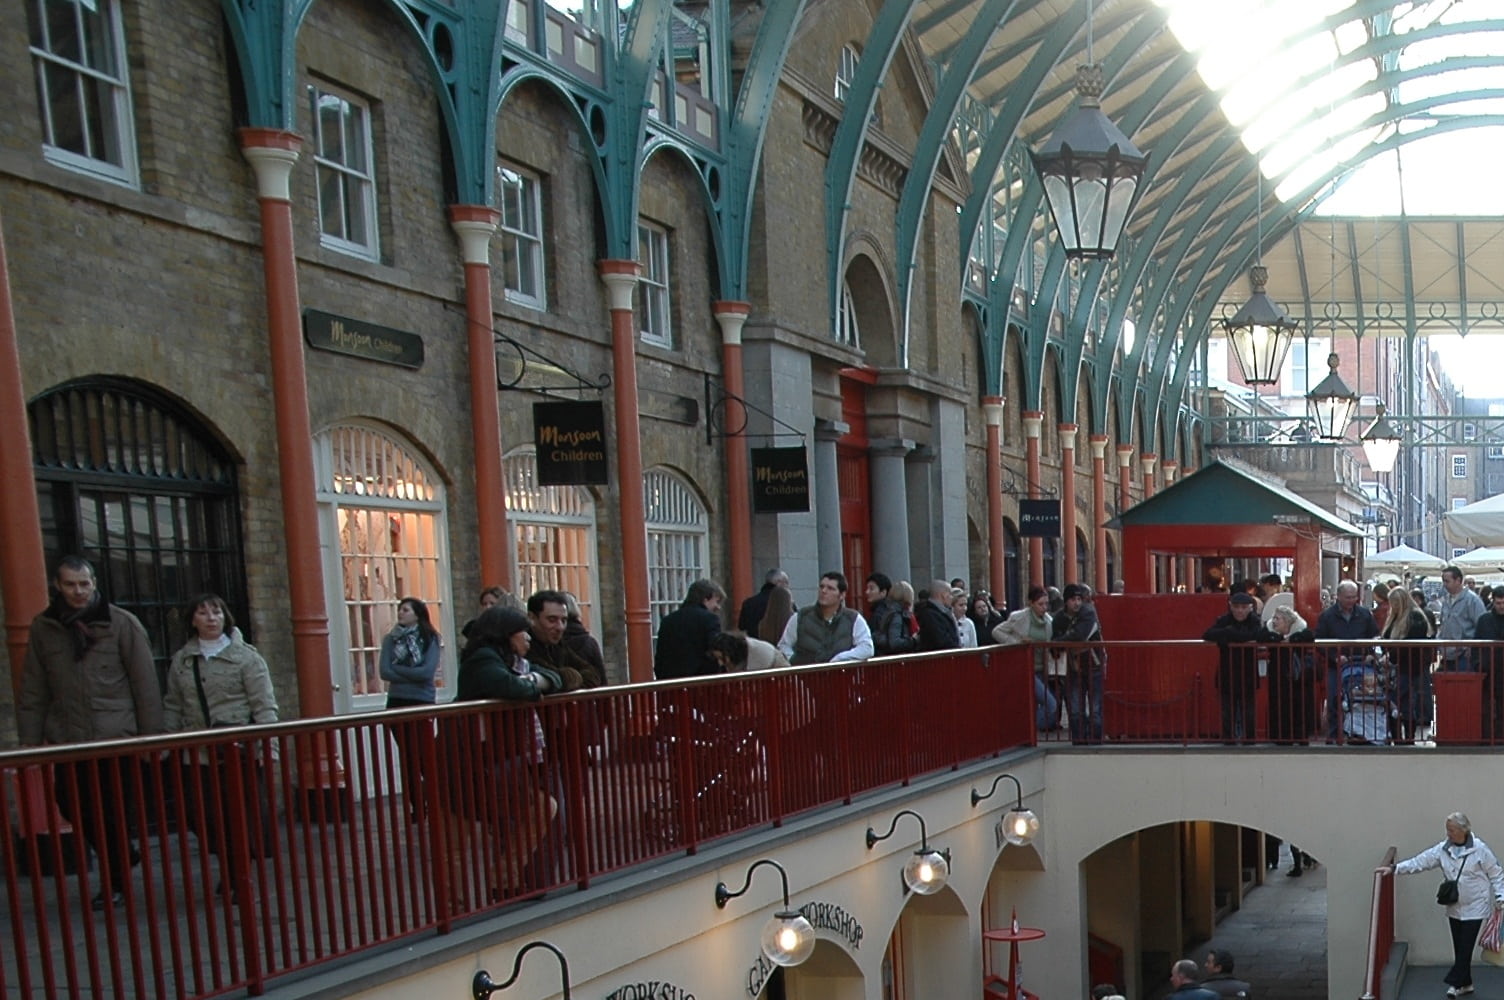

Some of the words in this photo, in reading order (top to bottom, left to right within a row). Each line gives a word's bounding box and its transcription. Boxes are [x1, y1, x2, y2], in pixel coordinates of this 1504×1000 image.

[539, 425, 601, 448] Monsoon
[551, 449, 604, 462] Children
[756, 466, 805, 484] Monsoon
